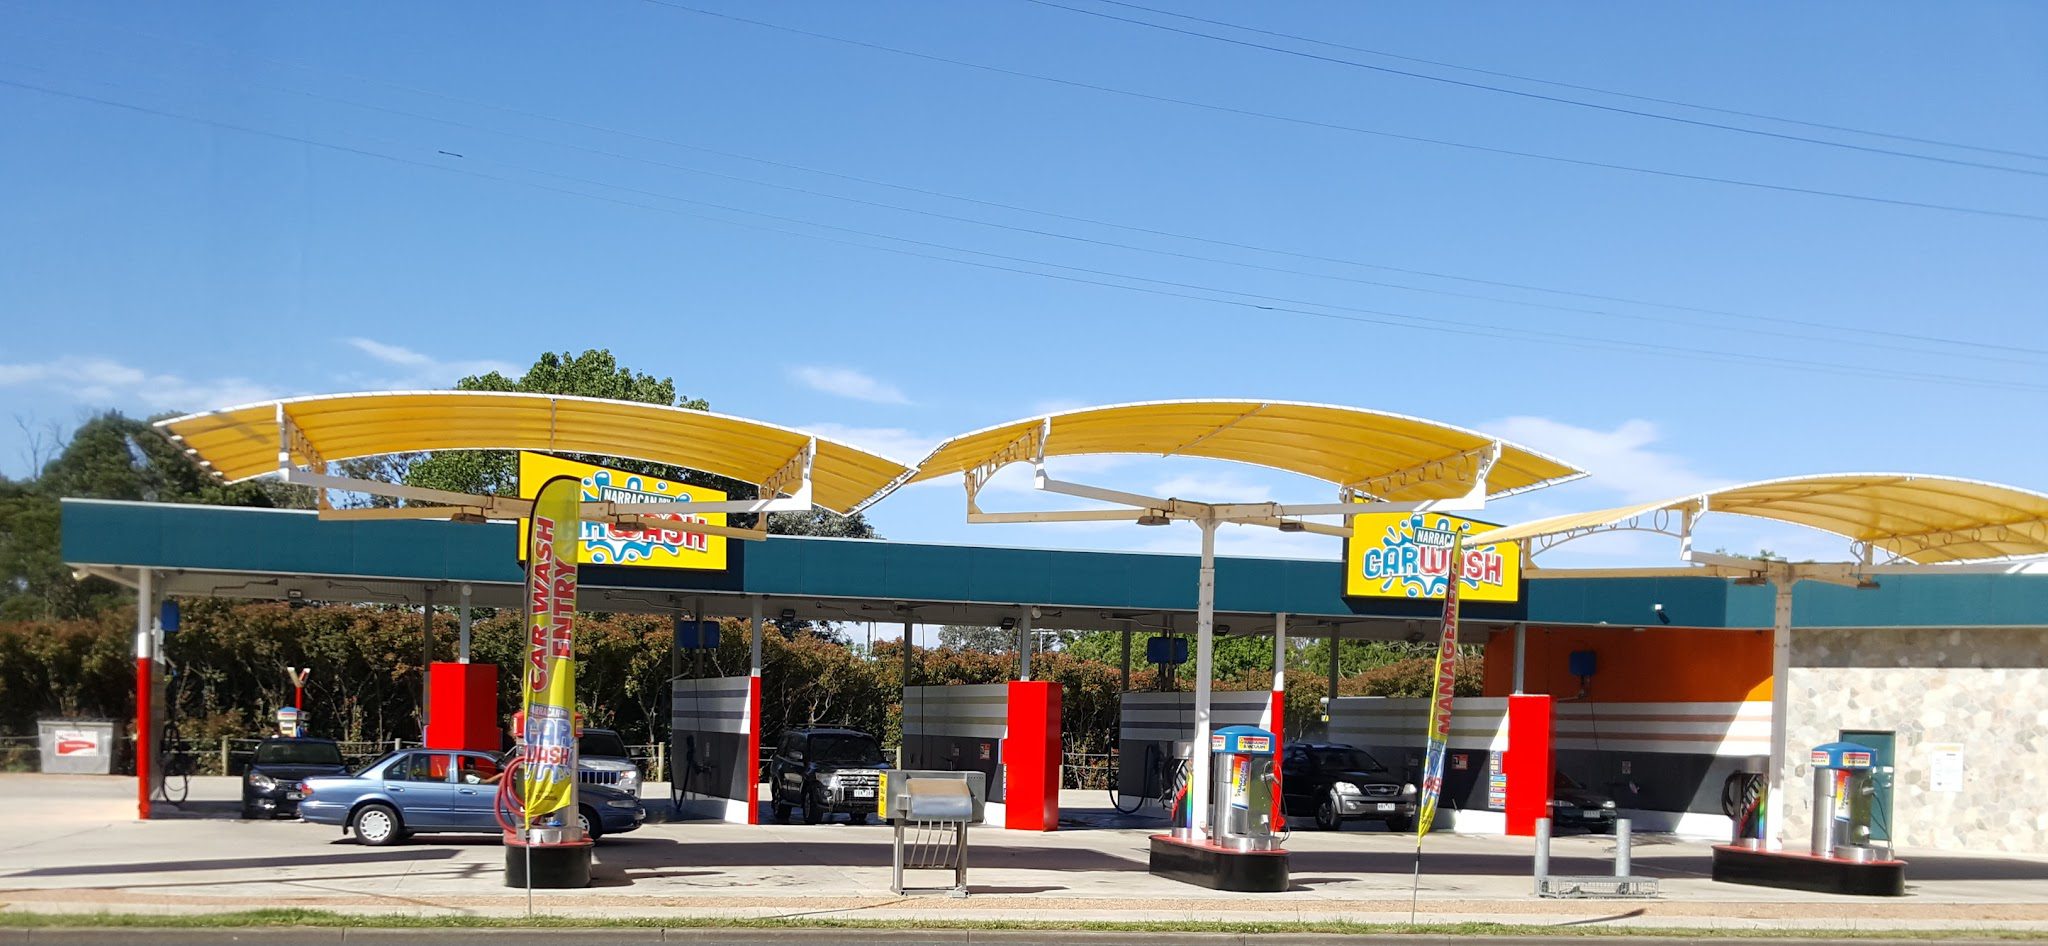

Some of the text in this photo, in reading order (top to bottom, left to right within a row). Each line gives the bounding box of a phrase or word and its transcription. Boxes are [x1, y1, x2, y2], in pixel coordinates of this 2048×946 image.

[530, 516, 554, 692] CAR WASH
[552, 557, 577, 659] ENTRY
[1437, 562, 1459, 736] MANAGEMEN
